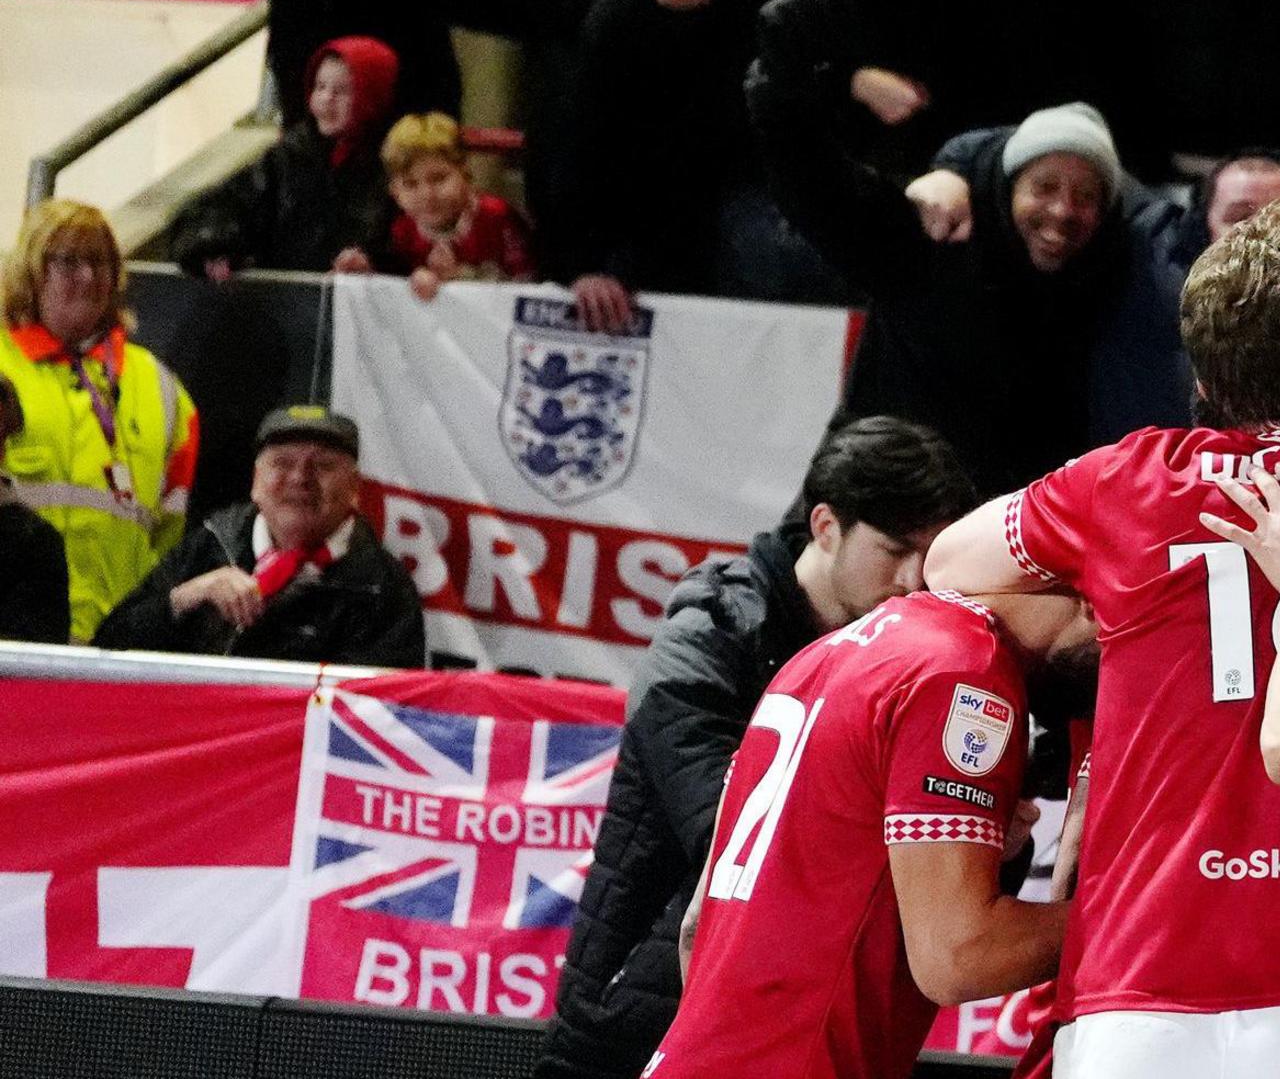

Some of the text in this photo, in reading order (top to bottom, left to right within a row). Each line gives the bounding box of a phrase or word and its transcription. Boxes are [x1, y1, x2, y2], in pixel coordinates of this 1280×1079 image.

[383, 494, 750, 642] BRIS
[959, 694, 1006, 719] sky bet
[1226, 686, 1241, 695] EFL
[961, 752, 980, 768] EFL
[355, 783, 442, 837] THE
[707, 692, 825, 901] 21
[353, 937, 567, 1019] BRIS
